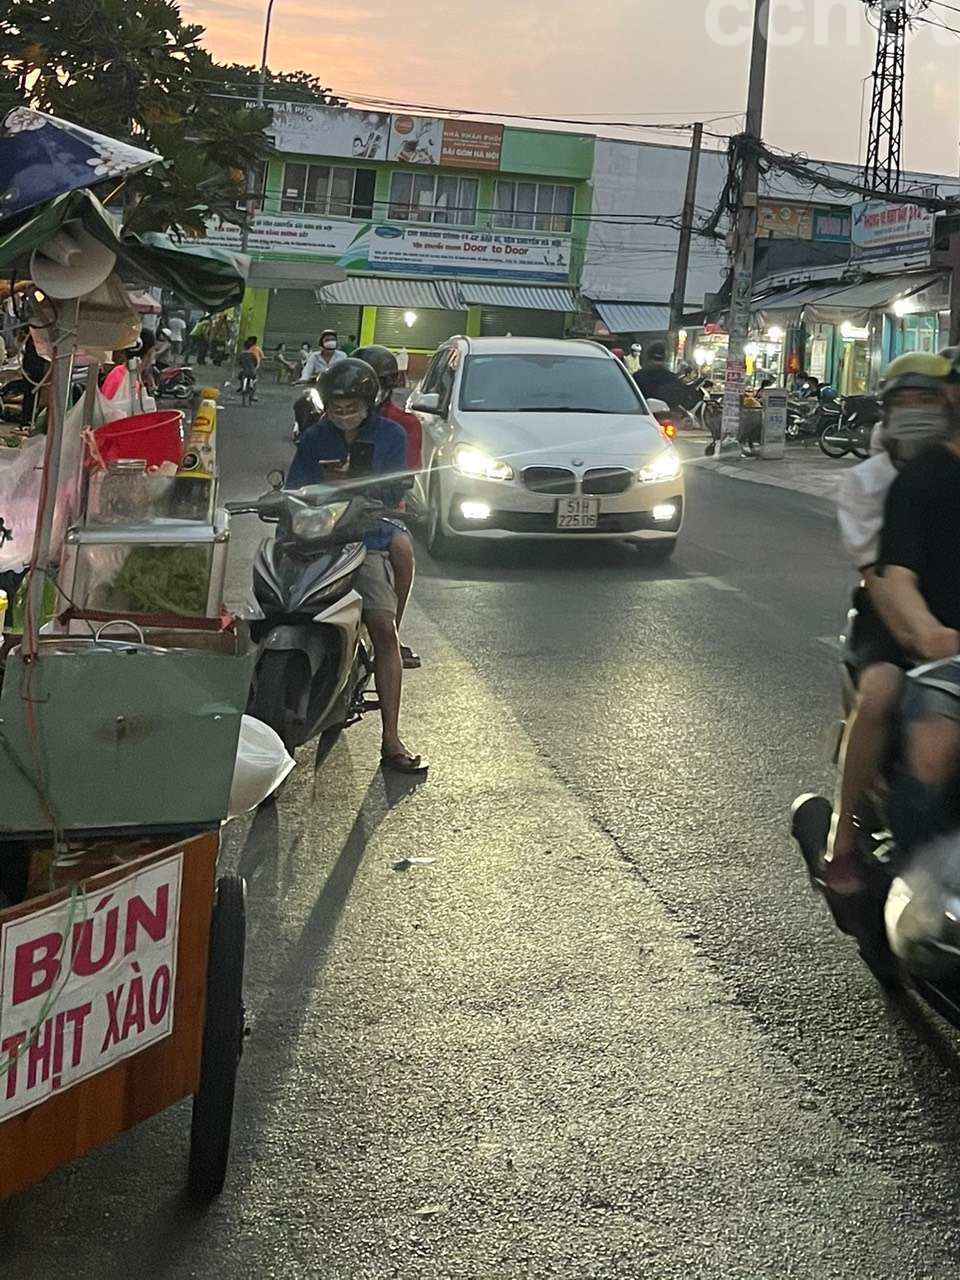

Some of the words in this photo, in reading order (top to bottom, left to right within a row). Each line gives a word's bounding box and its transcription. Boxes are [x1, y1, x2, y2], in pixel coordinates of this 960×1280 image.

[463, 242, 488, 252] Door
[491, 245, 503, 254] to
[504, 245, 529, 255] Door
[12, 882, 170, 1006] BÚN
[1, 1001, 93, 1101] THỊT
[100, 961, 171, 1055] XÀO
